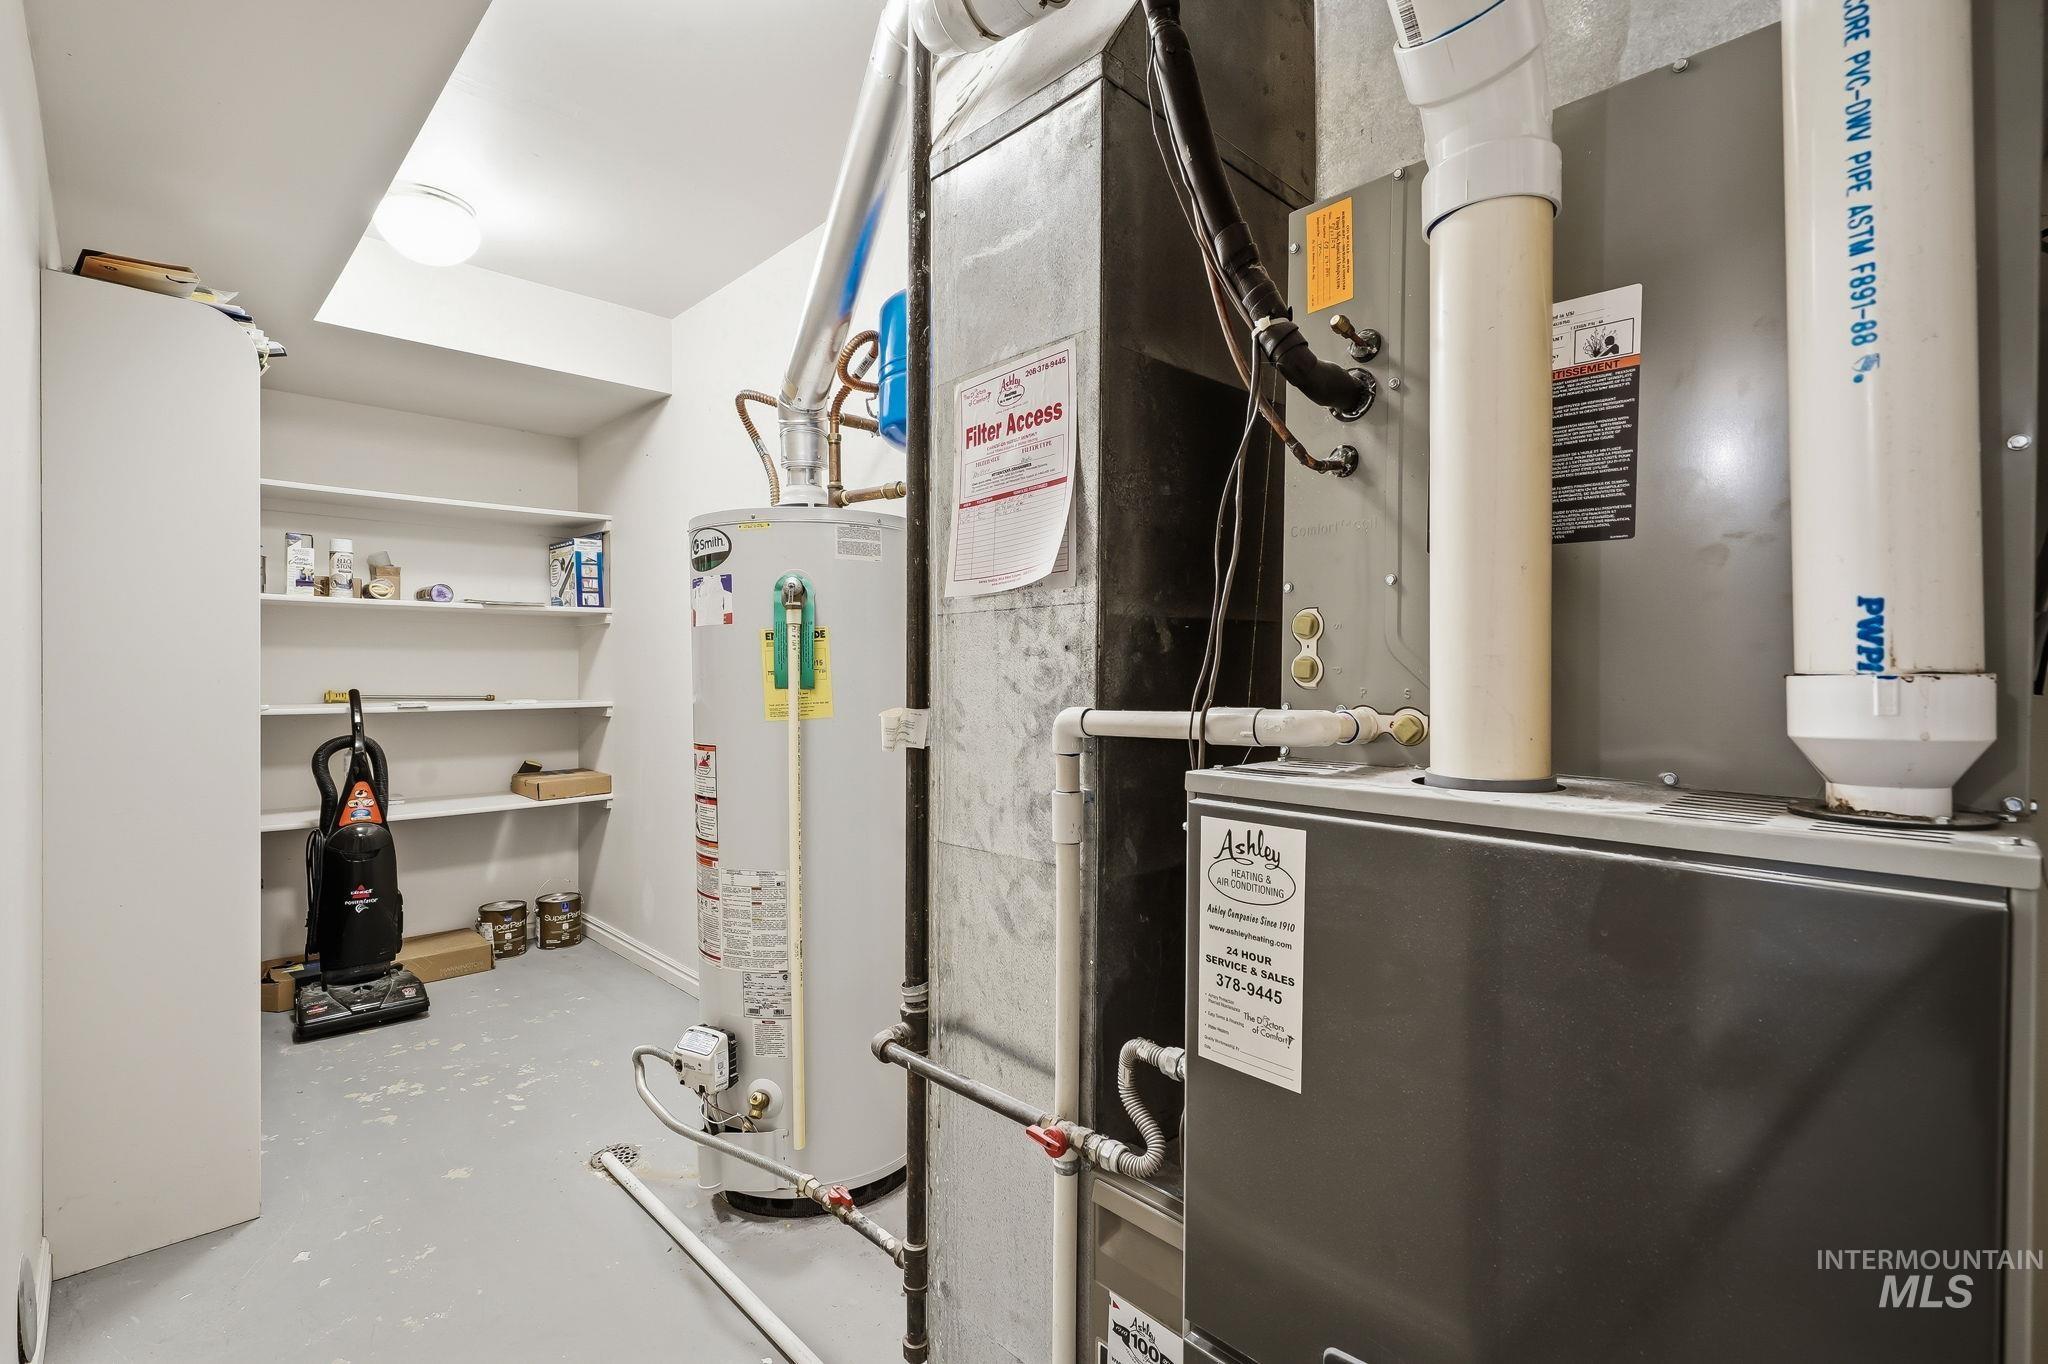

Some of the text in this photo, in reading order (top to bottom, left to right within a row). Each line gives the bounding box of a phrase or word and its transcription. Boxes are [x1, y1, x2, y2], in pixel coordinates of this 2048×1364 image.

[1846, 151, 1873, 197] PIPE
[1847, 205, 1875, 257] ASTM
[1849, 262, 1878, 346] F891-88
[965, 421, 1002, 450] Filter
[1006, 402, 1063, 436] Access
[700, 536, 724, 550] Smith
[1403, 688, 1412, 700] S
[1213, 828, 1281, 867] Ashley
[1216, 876, 1285, 899] AIR CONDITIONING
[1231, 868, 1271, 885] HEATING &
[1206, 903, 1296, 933] Ashley Companies Since 1910
[1208, 923, 1293, 950] www.ashleyheating.com
[1226, 946, 1272, 966] 24 HOUR
[1205, 954, 1295, 987] SERVICE & SALES
[1216, 973, 1283, 1005] 378-9445
[1243, 1011, 1255, 1023] The
[1252, 1026, 1259, 1034] of
[1130, 1317, 1156, 1344] Ashley
[1131, 1333, 1159, 1363] 100
